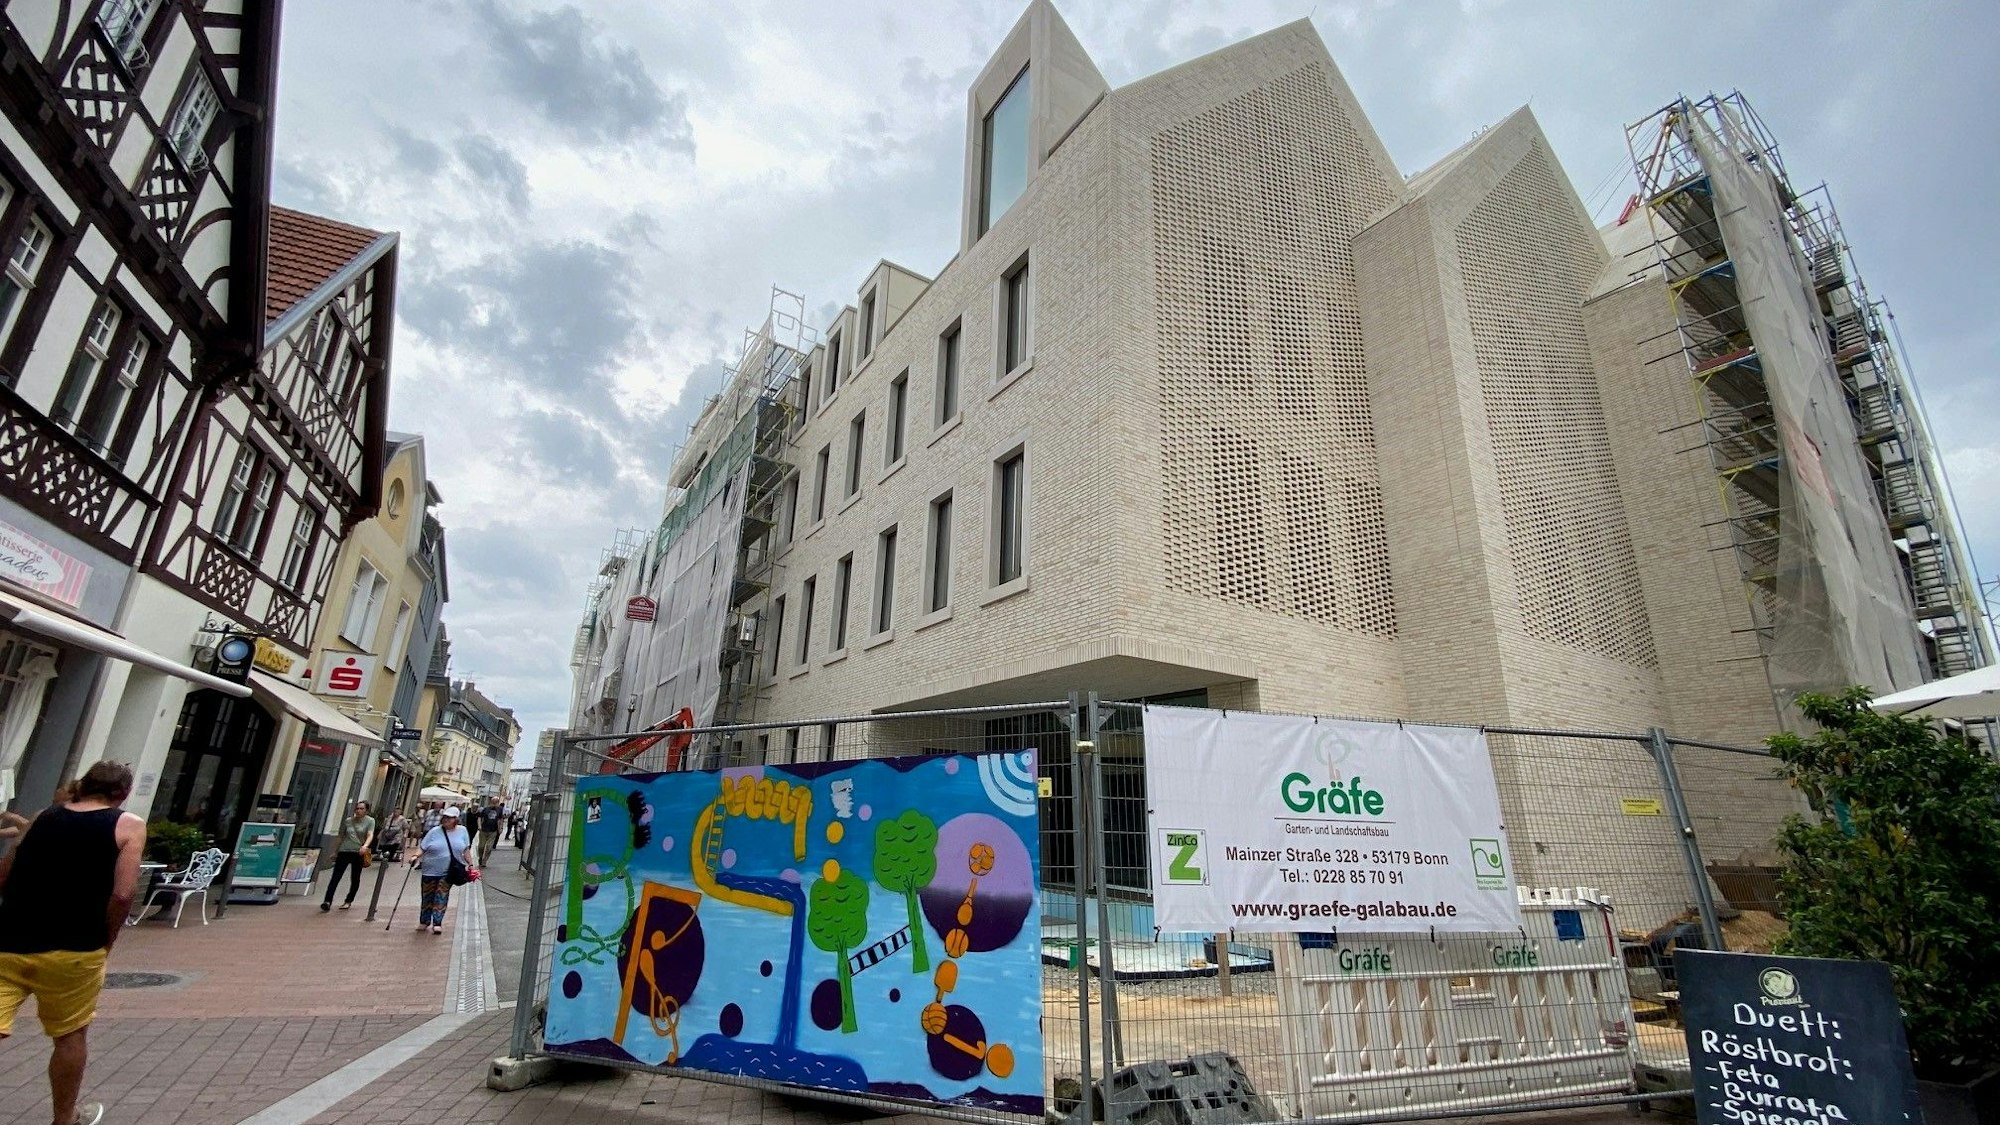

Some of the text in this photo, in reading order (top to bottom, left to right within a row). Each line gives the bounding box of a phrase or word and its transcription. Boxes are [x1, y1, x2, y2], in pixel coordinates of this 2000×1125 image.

[0, 551, 48, 581] adeus
[1281, 772, 1384, 816] Gräfe
[1167, 834, 1198, 846] ZinCo
[1285, 823, 1389, 837] Garten- und Landschaftsbau
[1225, 846, 1449, 866] Mainzer Straße 328 53179 Bonn
[1279, 868, 1404, 885] Tel.: 0228 85 70 91
[1231, 900, 1457, 921] www.graefe-galabau.de
[1339, 948, 1392, 972] Gräfe
[1490, 945, 1538, 967] Gräfe
[1733, 1002, 1842, 1039] Duett:
[1701, 1029, 1854, 1081] Röstbrot:
